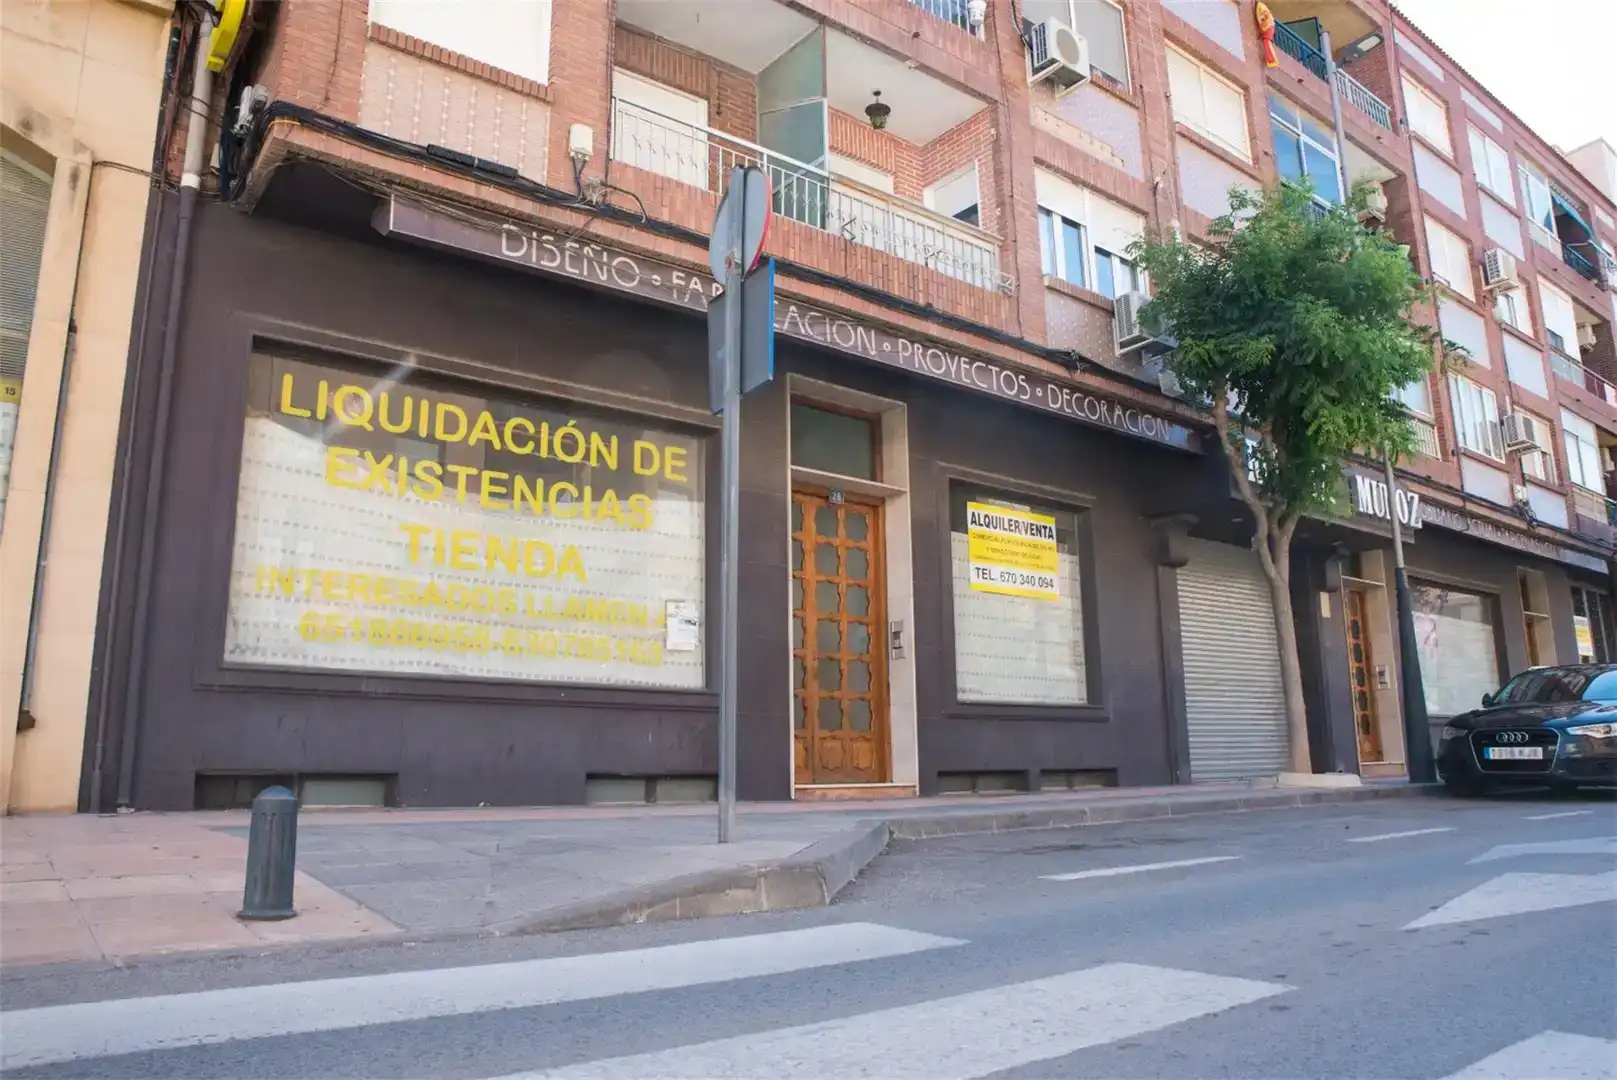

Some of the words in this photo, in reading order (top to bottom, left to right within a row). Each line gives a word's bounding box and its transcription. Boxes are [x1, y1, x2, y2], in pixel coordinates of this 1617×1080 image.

[500, 223, 641, 288] DISEÑO
[898, 338, 1031, 400] PROYECTOS
[1047, 383, 1170, 441] DECORACION
[280, 373, 619, 471] LIQUIDACIÓN
[633, 441, 689, 483] DE
[325, 446, 655, 530] EXISTENCIAS
[401, 524, 588, 582] TIENDA
[975, 566, 998, 581] TEL.
[1000, 571, 1017, 584] 670
[1019, 574, 1035, 587] 340
[1037, 577, 1054, 589] 094
[254, 564, 517, 614] INTERESADOS
[526, 592, 648, 627] LLAMEN
